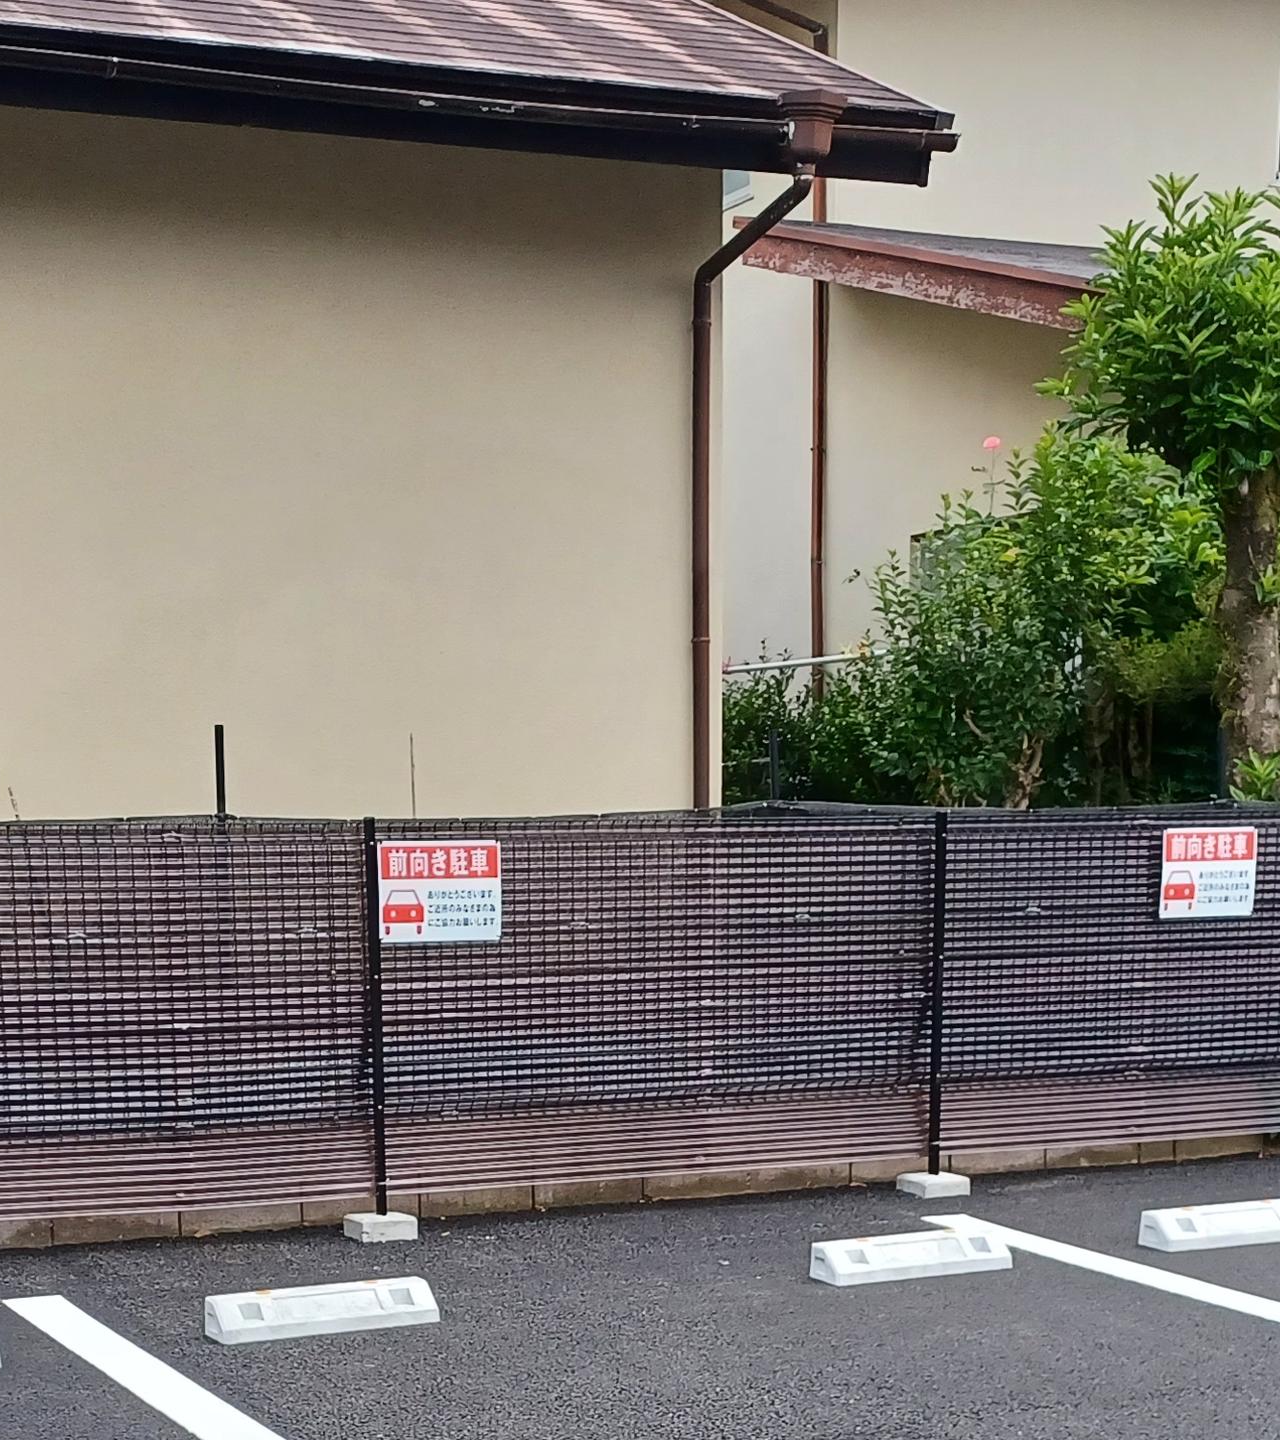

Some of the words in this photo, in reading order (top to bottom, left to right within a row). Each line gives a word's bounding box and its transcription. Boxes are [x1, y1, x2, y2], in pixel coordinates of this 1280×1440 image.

[1171, 833, 1248, 859] 前向き駐車
[388, 848, 489, 877] 前向き駐車
